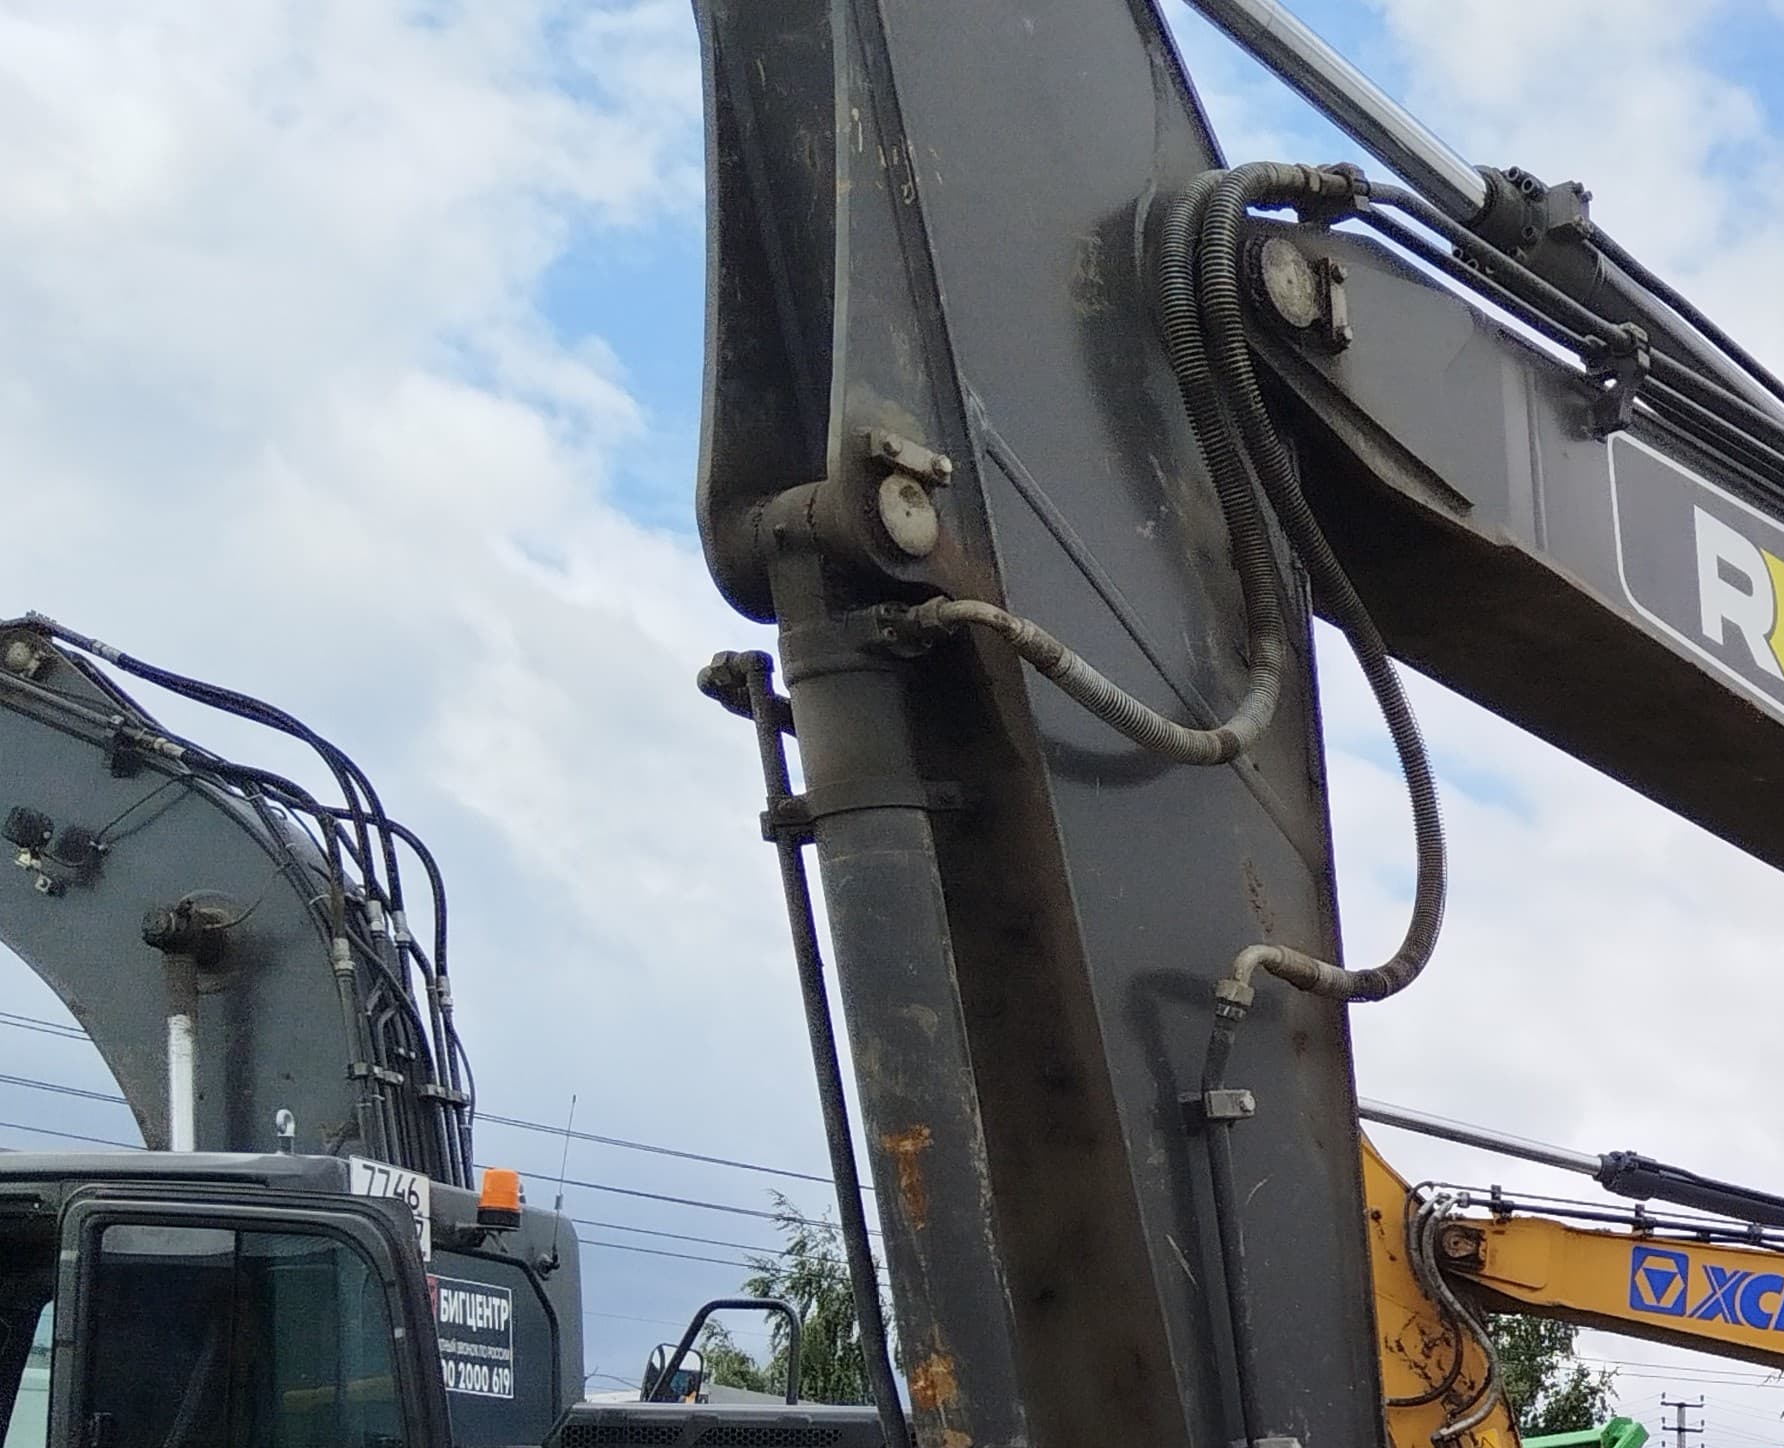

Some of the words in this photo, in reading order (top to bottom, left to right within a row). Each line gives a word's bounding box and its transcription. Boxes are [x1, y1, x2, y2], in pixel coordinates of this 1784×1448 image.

[362, 1163, 420, 1211] 7746
[440, 1287, 509, 1332] БИГЦЕНТР
[458, 1361, 489, 1392] 2000
[492, 1366, 510, 1395] 619
